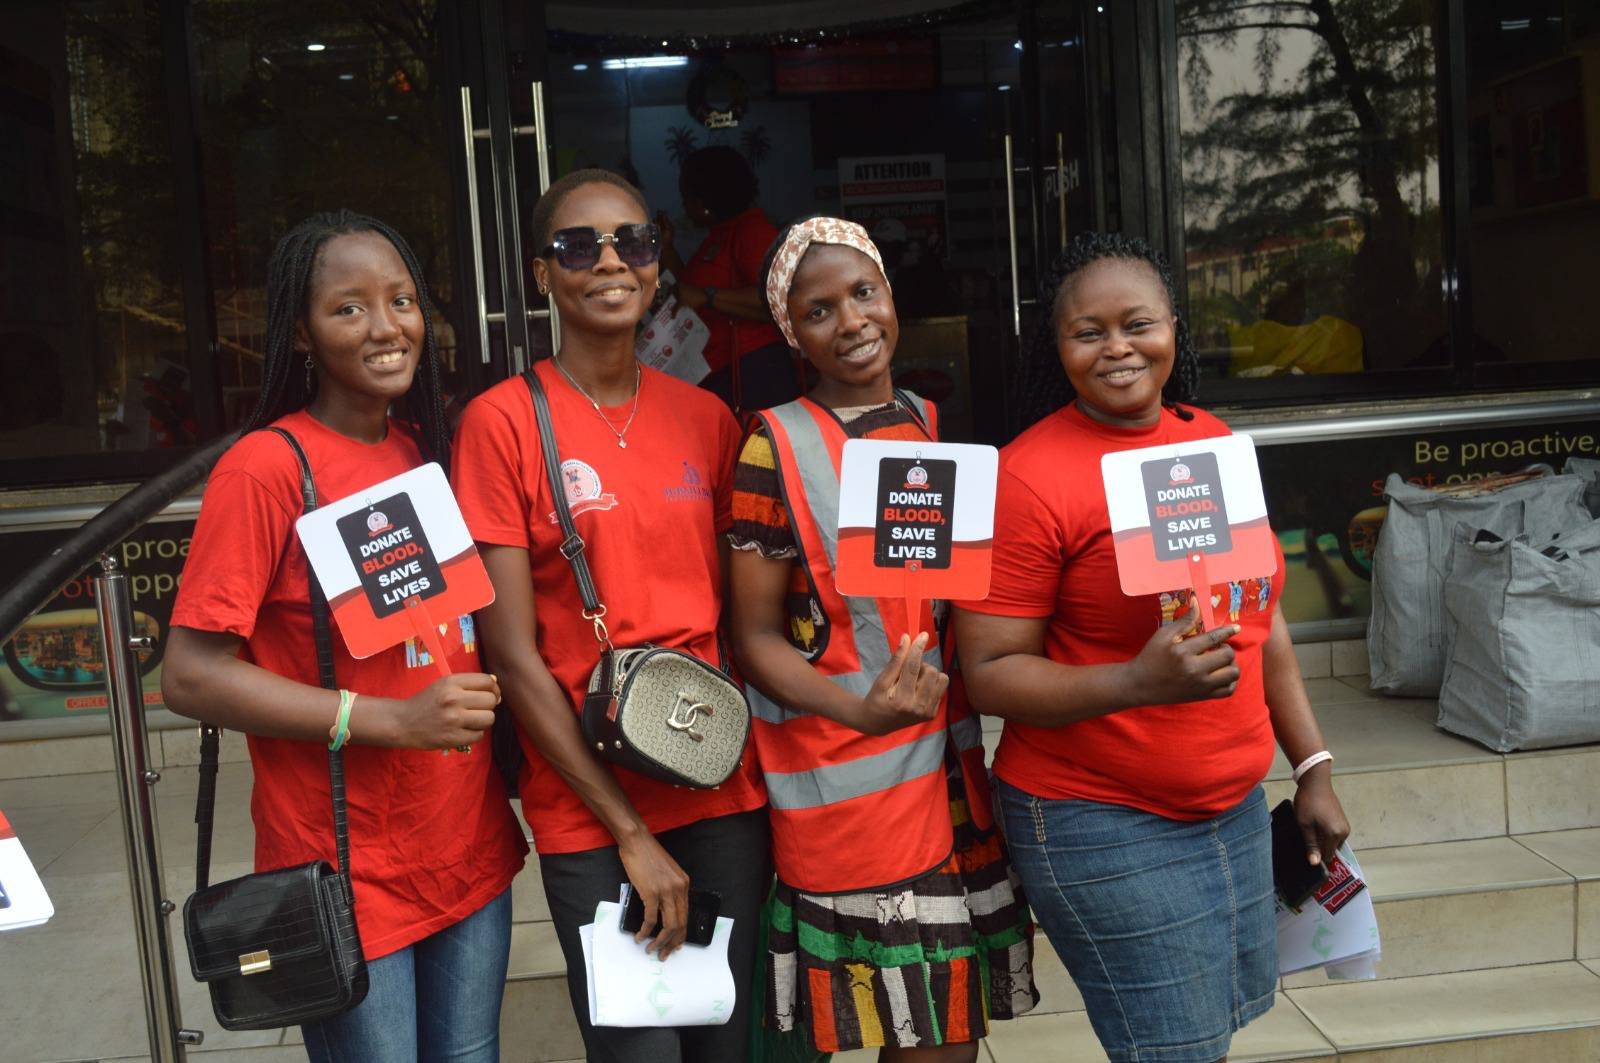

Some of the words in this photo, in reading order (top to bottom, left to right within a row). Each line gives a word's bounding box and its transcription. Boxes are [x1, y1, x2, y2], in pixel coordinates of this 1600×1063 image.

[854, 161, 931, 179] ATTENTION
[1414, 440, 1450, 464] Be
[889, 492, 942, 505] DONATE
[1157, 484, 1210, 502] DONATE
[884, 508, 946, 525] BLOOD,
[1155, 499, 1218, 518] BLOOD,
[892, 527, 935, 540] SAVE
[1168, 517, 1212, 533] SAVE
[360, 527, 412, 557] DONATE
[1168, 534, 1217, 551] LIVES
[121, 538, 192, 567] proa
[362, 542, 424, 574] BLOOD,
[889, 546, 936, 559] LIVES
[379, 561, 422, 588] SAVE
[383, 577, 431, 605] LIVES
